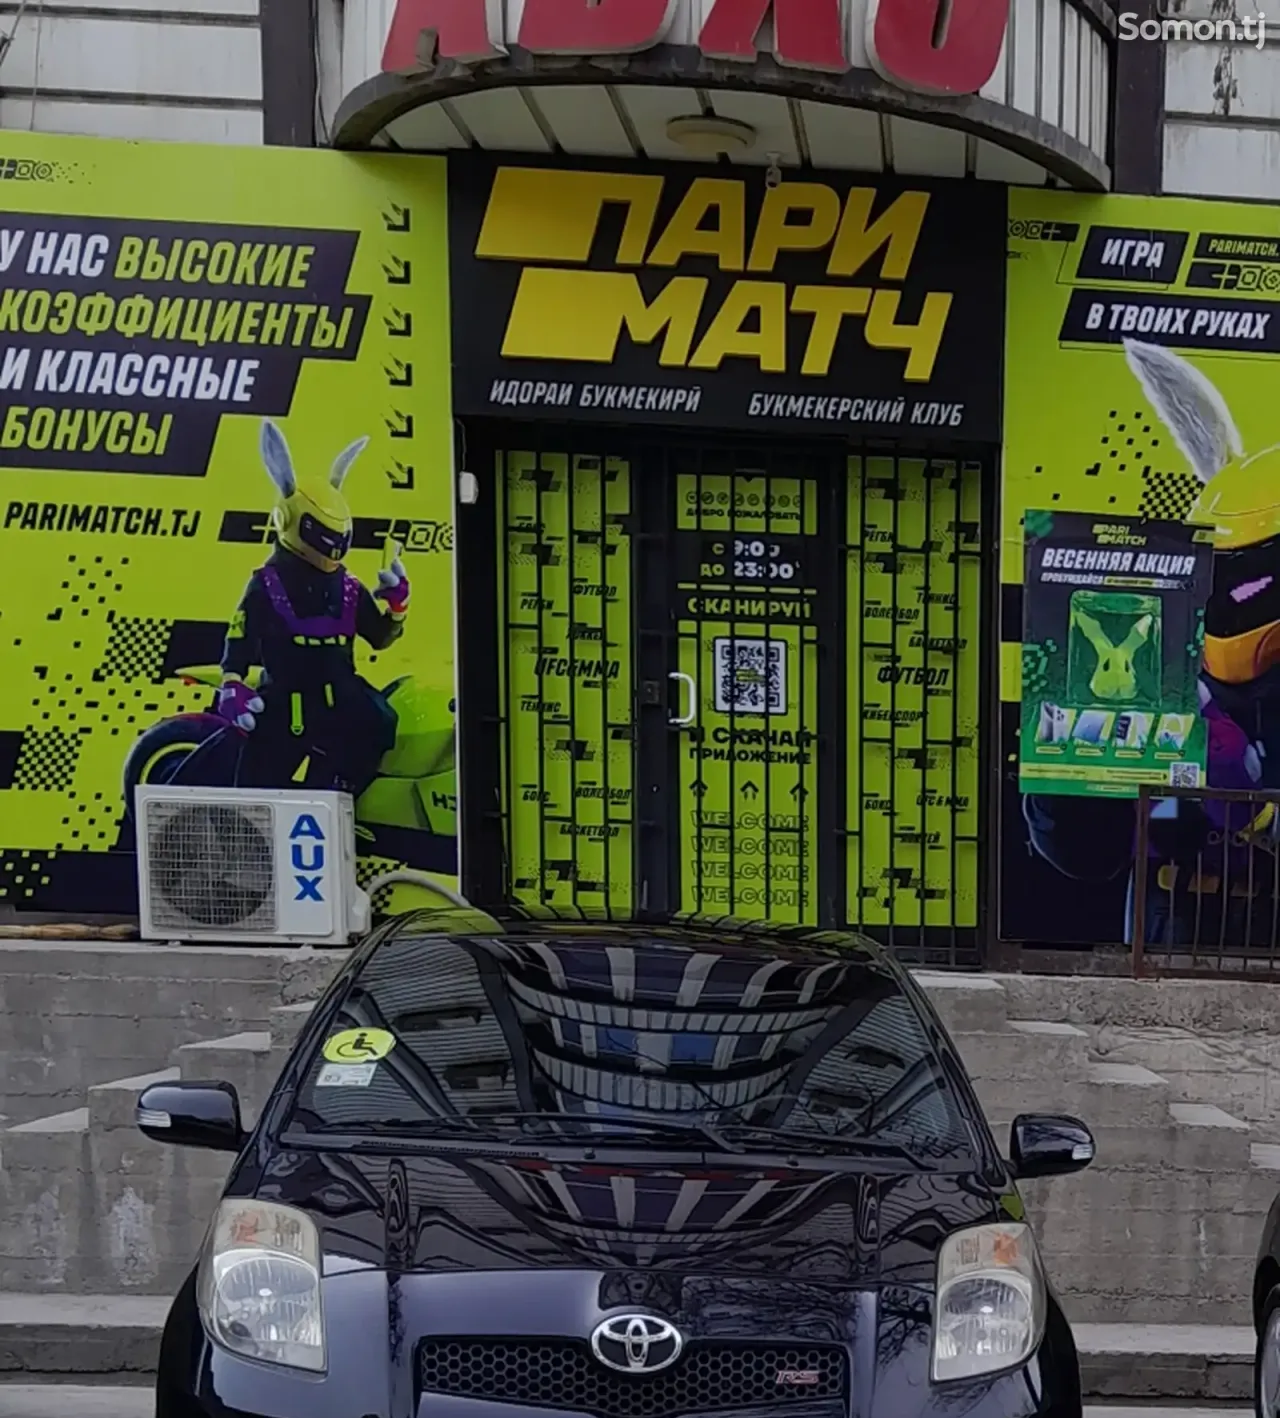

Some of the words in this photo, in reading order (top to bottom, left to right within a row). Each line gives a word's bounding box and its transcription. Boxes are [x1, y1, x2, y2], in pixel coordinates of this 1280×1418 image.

[474, 166, 931, 281] ПАРИ
[0, 229, 24, 271] У
[26, 231, 109, 277] НАС
[114, 236, 315, 289] ВЫСОКИЕ
[1101, 238, 1165, 268] ИГРА
[0, 288, 354, 349] КОЭФФИЦИЕНТЫ
[500, 267, 954, 384] МАТЧ
[1085, 303, 1105, 329] В
[1108, 304, 1190, 334] ТВОИХ
[1190, 309, 1271, 340] РУКАХ
[0, 347, 30, 390] И
[34, 350, 260, 402] КЛАССНЫЕ
[489, 379, 573, 406] ИДОРАИ
[748, 393, 905, 423] БУКМЕКЕРСКИЙ
[910, 402, 964, 426] КЛУБ
[1, 406, 173, 456] БОНУСЫ
[3, 501, 202, 538] PARIMATCH.TJ
[1041, 548, 1133, 573] ВЕСЕННЯЯ
[1133, 552, 1196, 576] АКЦИЯ
[864, 606, 920, 620] ВОЛЕБОЛ
[574, 787, 632, 799] ВОЛЕБОЛ
[289, 814, 325, 902] AUX
[776, 1370, 820, 1385] RS
